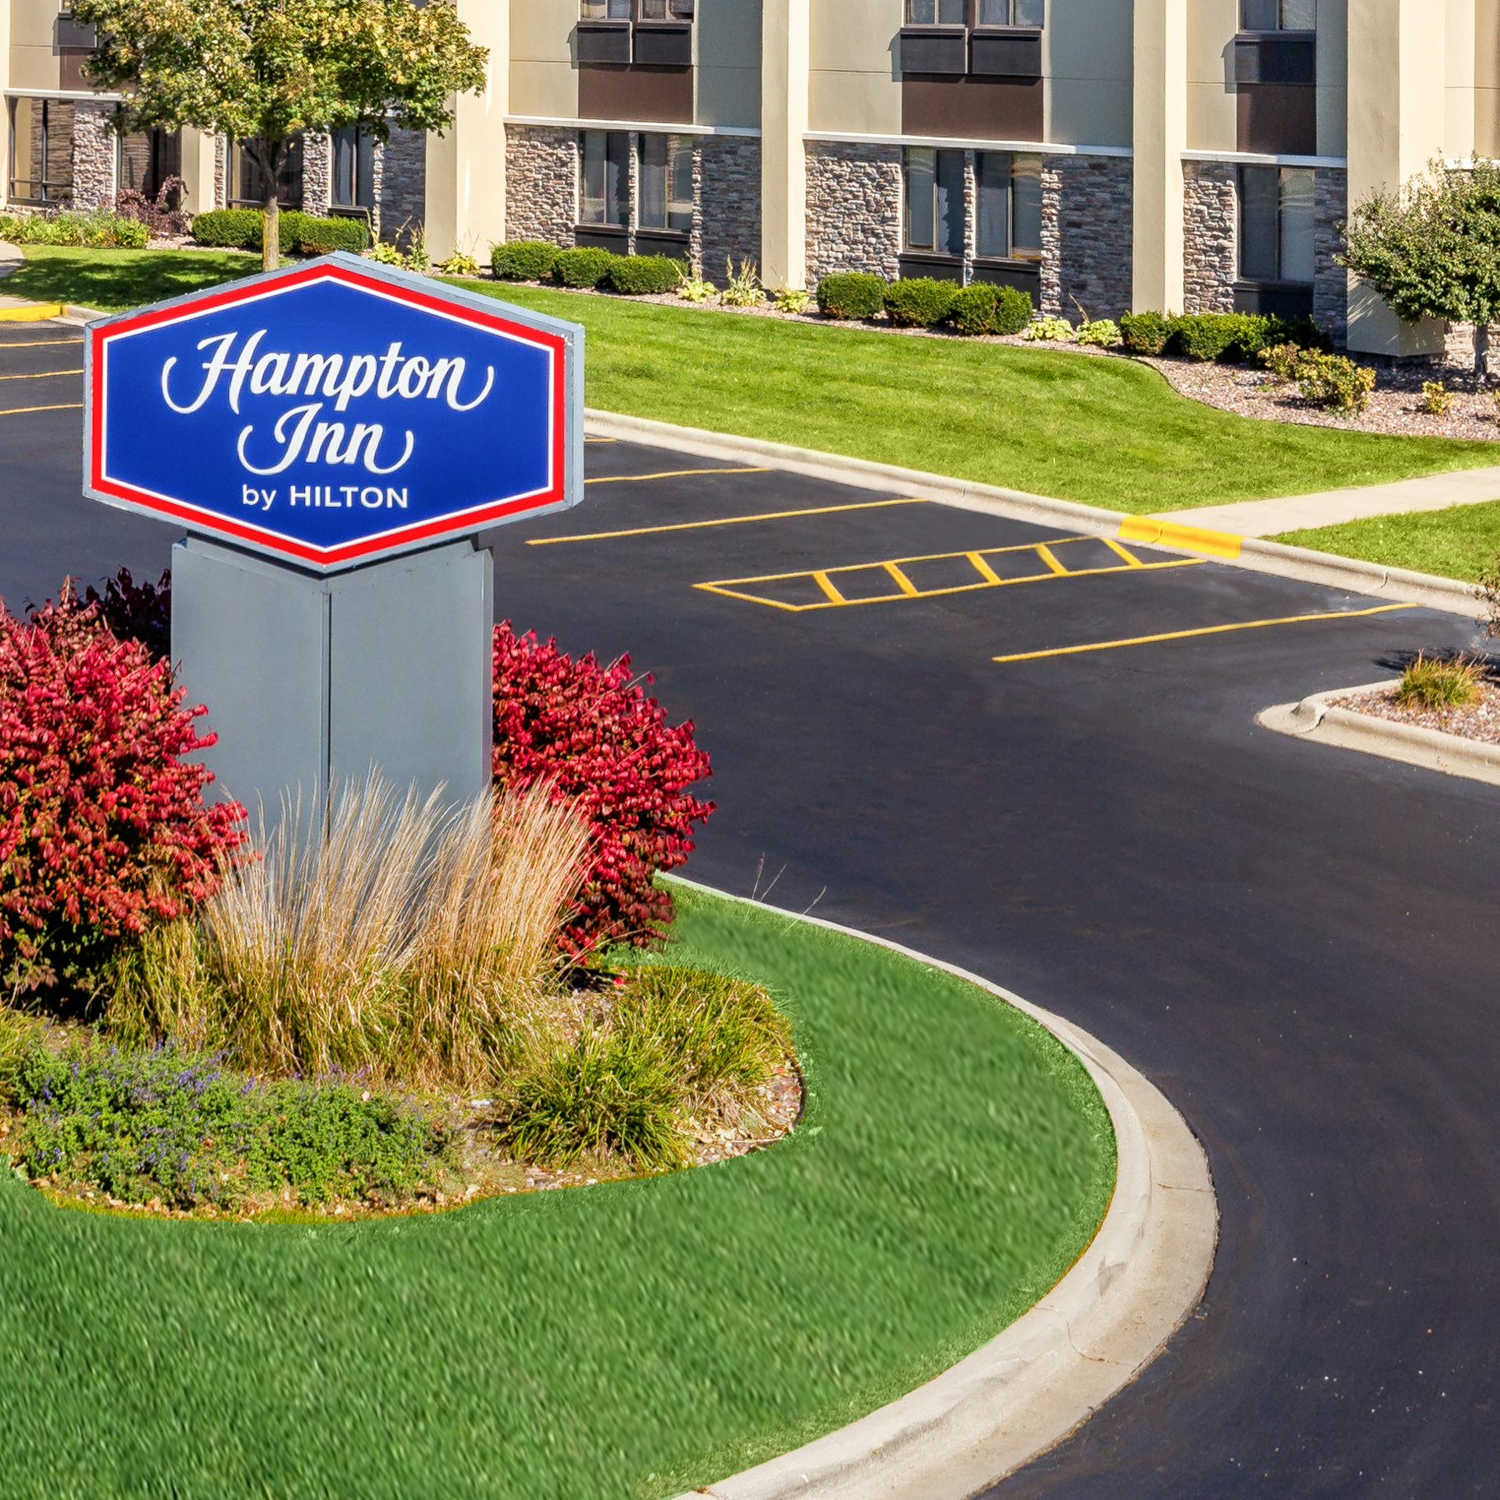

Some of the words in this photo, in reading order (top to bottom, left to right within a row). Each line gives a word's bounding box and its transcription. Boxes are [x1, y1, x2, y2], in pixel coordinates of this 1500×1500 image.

[161, 329, 494, 414] Hampton
[237, 402, 414, 476] Inn
[242, 483, 276, 511] by
[290, 485, 408, 508] HILTON
